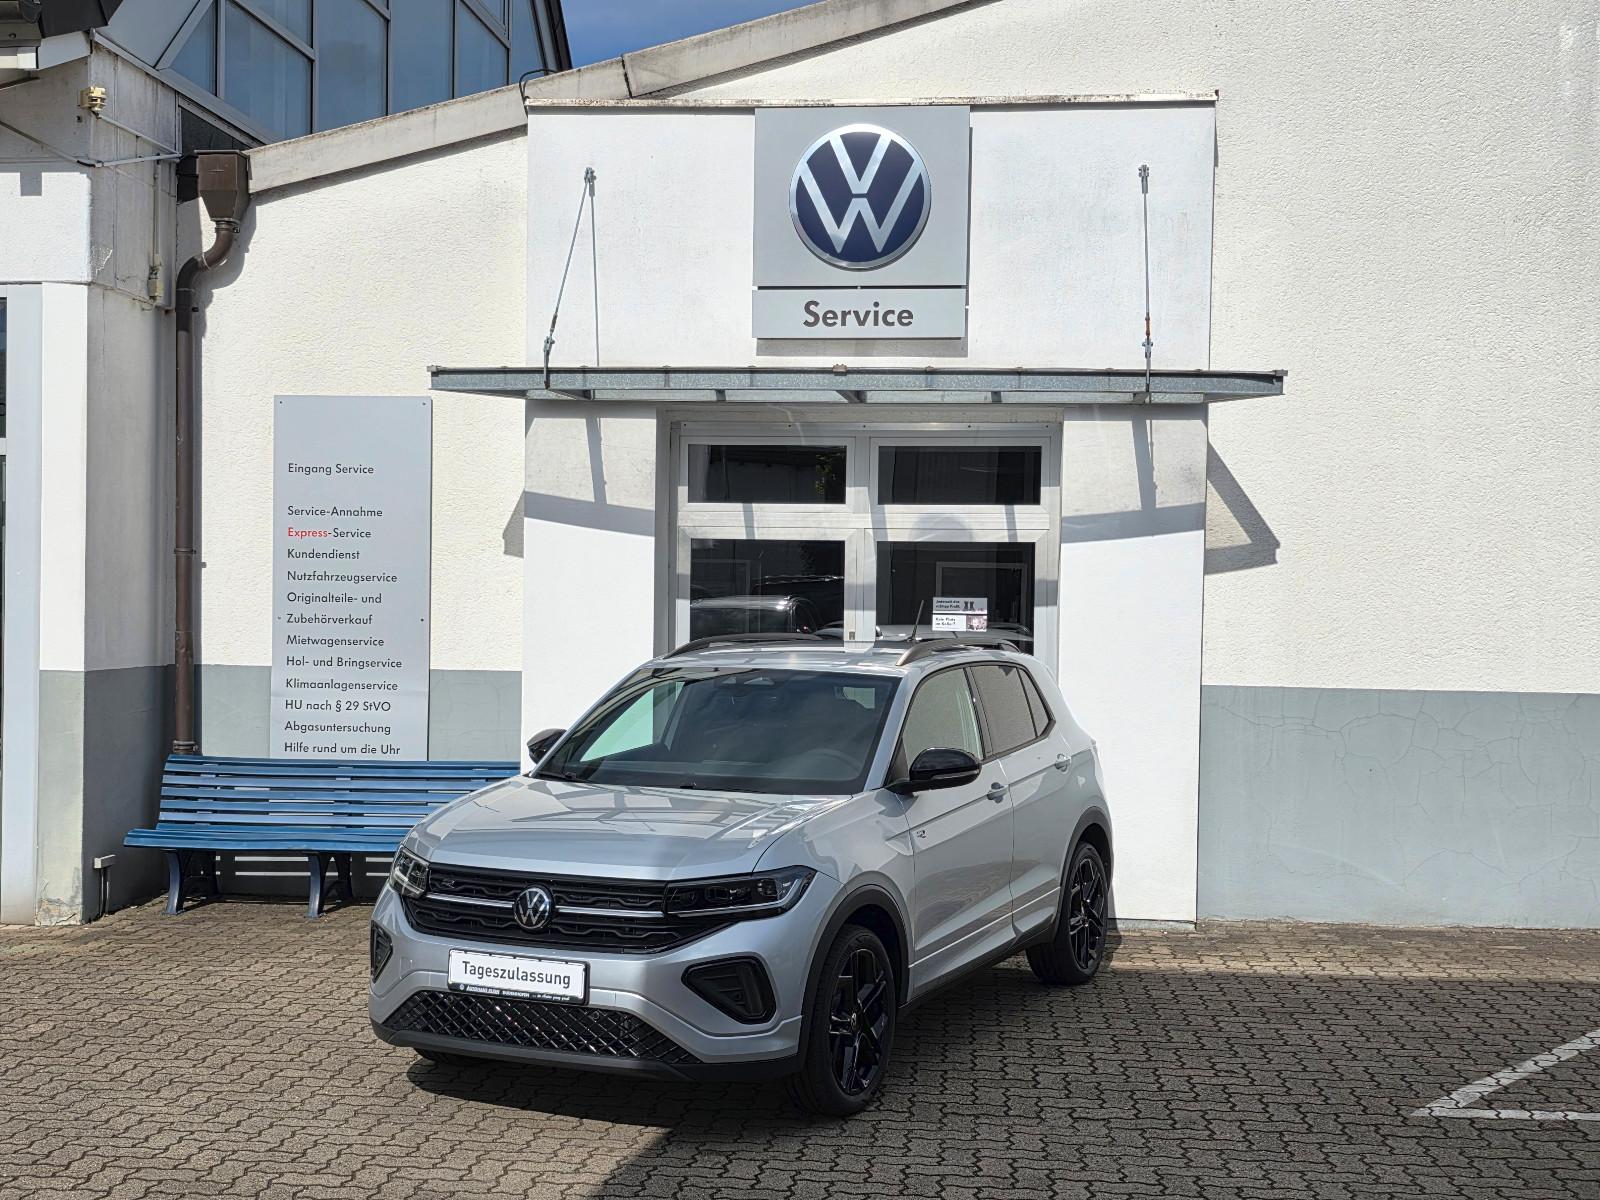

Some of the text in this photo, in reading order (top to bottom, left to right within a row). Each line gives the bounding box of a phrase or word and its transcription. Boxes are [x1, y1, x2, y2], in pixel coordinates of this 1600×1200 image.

[802, 300, 914, 328] Service
[288, 462, 374, 476] Eingang Service
[287, 506, 383, 517] Service-Annahme
[287, 527, 372, 540] Express-Service
[287, 548, 360, 560] Kundendienst
[287, 570, 398, 584] Nutzfahrzeugservice
[286, 591, 382, 605] Originalteile- und
[286, 613, 373, 625] Zubehörverkauf
[286, 634, 385, 647] Mietwagenservice
[286, 655, 403, 670] Hol- und Bringservice
[286, 678, 398, 692] Klimaanlagenservice
[285, 699, 391, 713] HU nach § 29 StVO
[284, 721, 392, 736] Abgasuntersuchung
[284, 742, 401, 755] Hilfe rund um die Uhr
[462, 960, 571, 989] Tageszulassung
